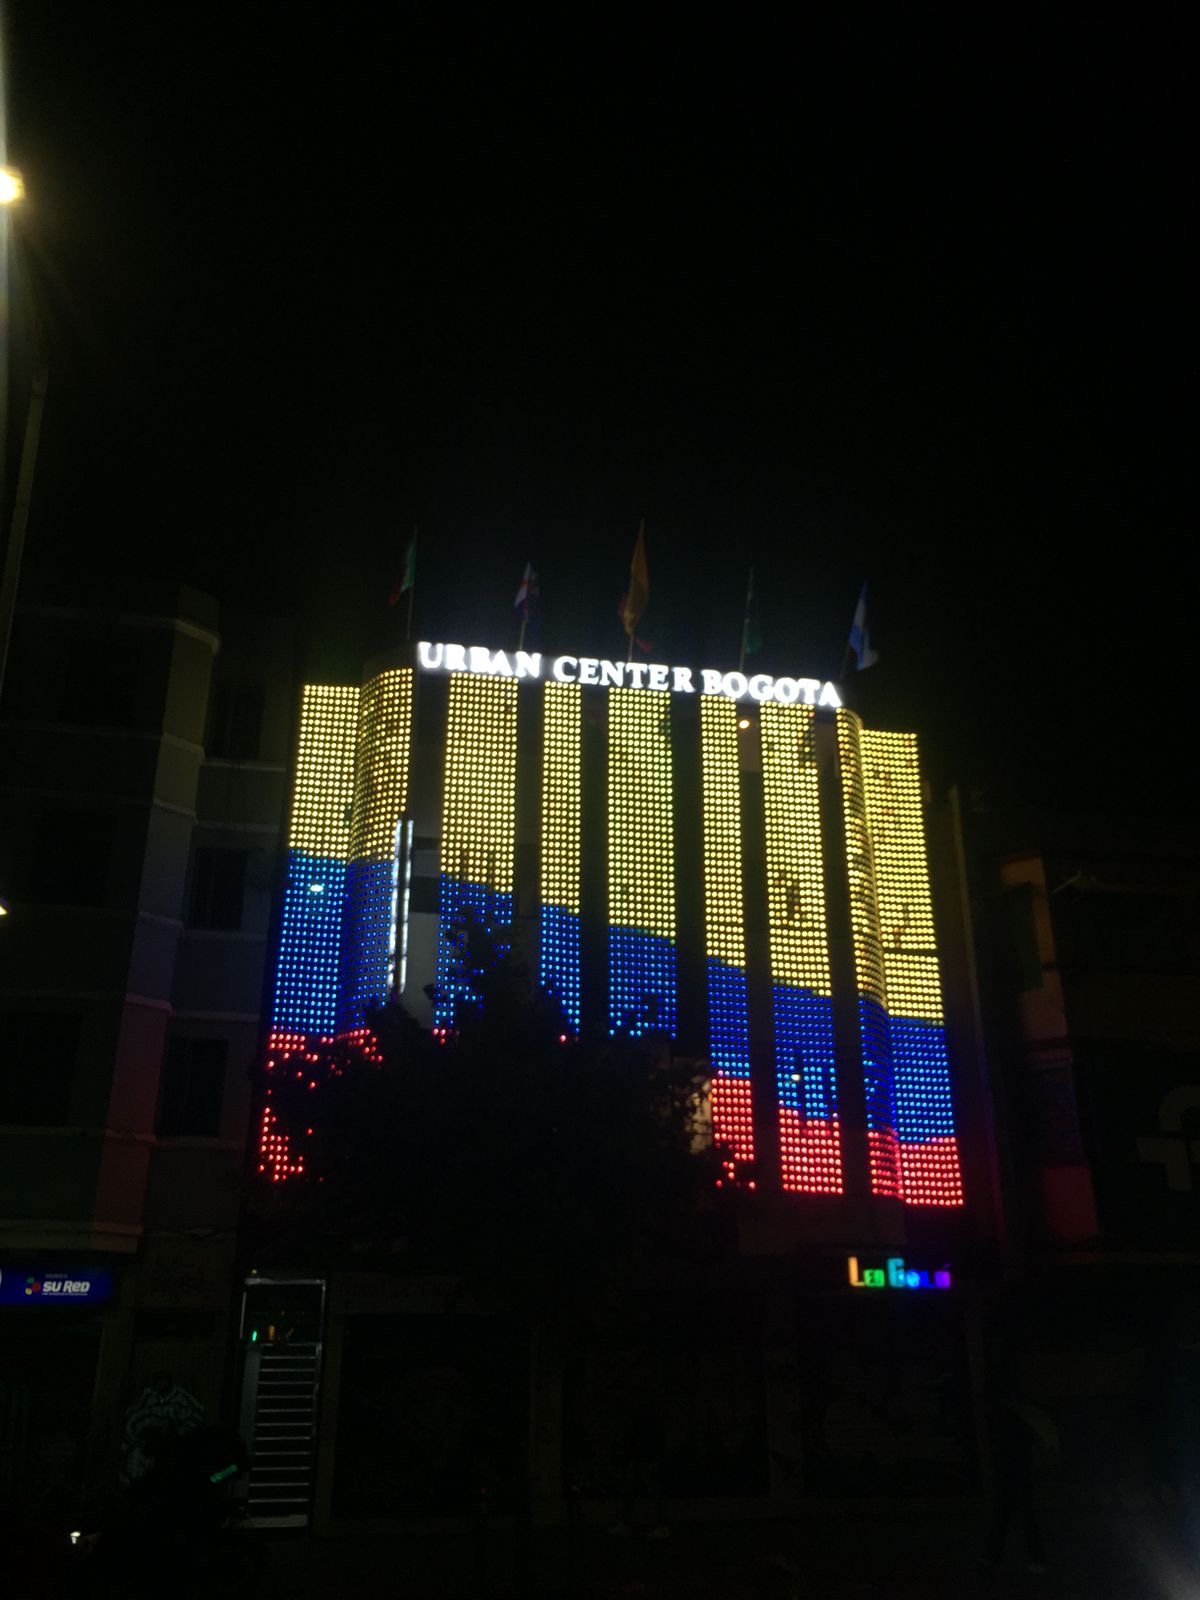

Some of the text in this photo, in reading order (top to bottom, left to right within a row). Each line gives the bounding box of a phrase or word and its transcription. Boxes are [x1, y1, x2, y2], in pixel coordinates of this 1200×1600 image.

[418, 641, 842, 707] URBAN CENTER BOGOTA
